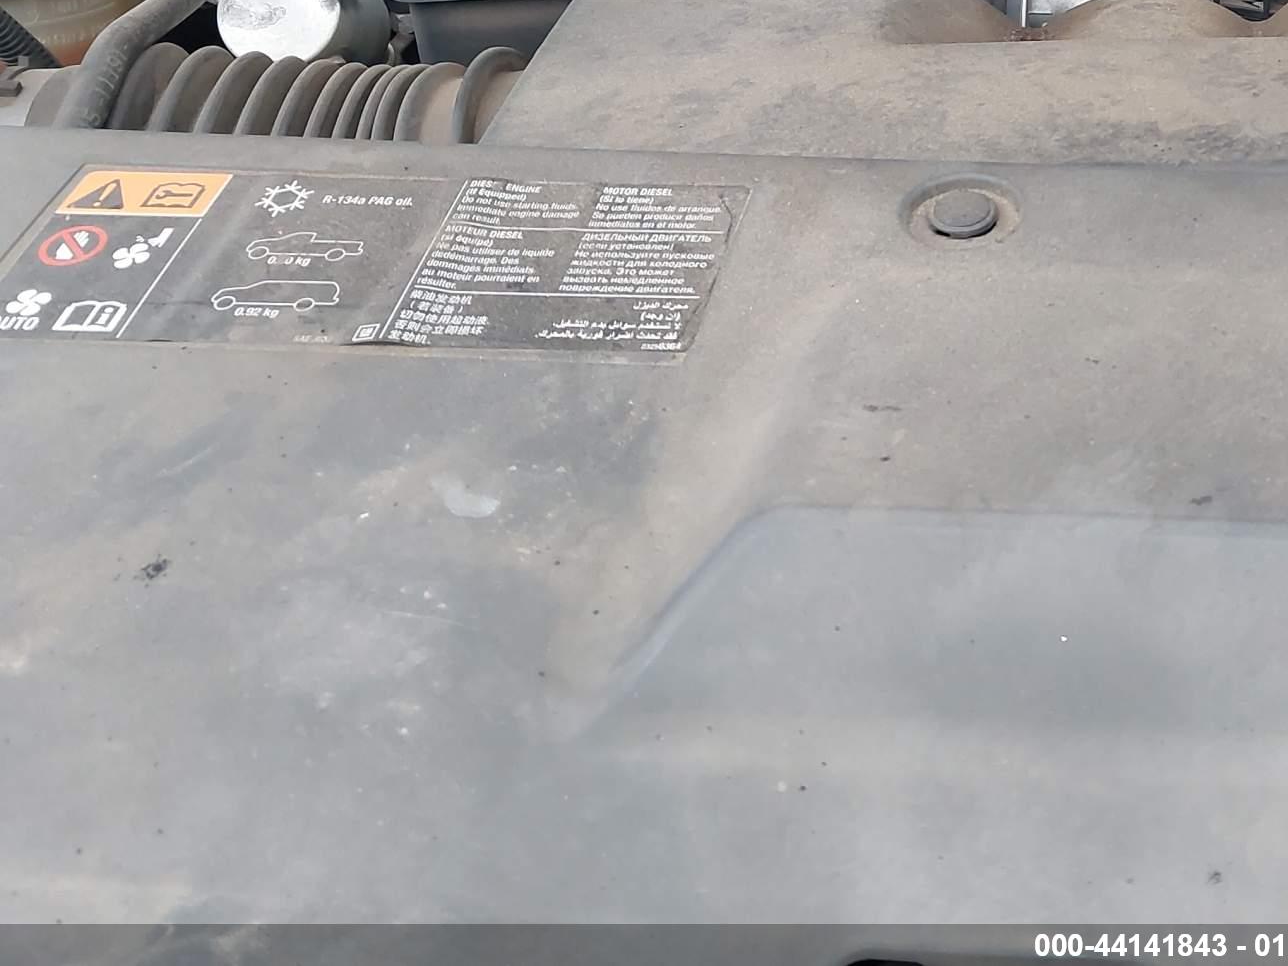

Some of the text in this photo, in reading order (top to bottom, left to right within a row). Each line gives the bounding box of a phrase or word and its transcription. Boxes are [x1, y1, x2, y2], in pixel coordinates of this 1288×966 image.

[506, 183, 543, 194] ENGINE
[603, 187, 673, 196] MOTOR DIESEL
[322, 194, 366, 205] R-134a
[368, 196, 394, 206] PAG
[478, 188, 527, 202] Equipped)
[462, 195, 474, 204] Do
[476, 196, 492, 205] not
[494, 200, 511, 208] use
[513, 201, 548, 211] starting
[508, 210, 541, 219] engine
[542, 210, 580, 219] damage
[592, 211, 604, 219] Se
[606, 212, 642, 221] pueden
[643, 212, 682, 222] producir
[588, 220, 640, 228] inmediatos
[445, 225, 523, 239] MOTEUR DIESEL
[649, 234, 712, 243] ДВИГАТЕЛЬ
[451, 244, 470, 252] pas
[472, 246, 506, 256] utiliser
[508, 248, 520, 256] de
[522, 248, 555, 258] liquide
[295, 256, 312, 267] kg
[500, 256, 520, 264] Des
[427, 258, 481, 274] dommages
[615, 267, 636, 275] Это
[437, 270, 472, 281] moteur
[474, 273, 525, 283] pourraient
[234, 306, 280, 318] 0.92 kg
[0, 316, 40, 330] UTO
